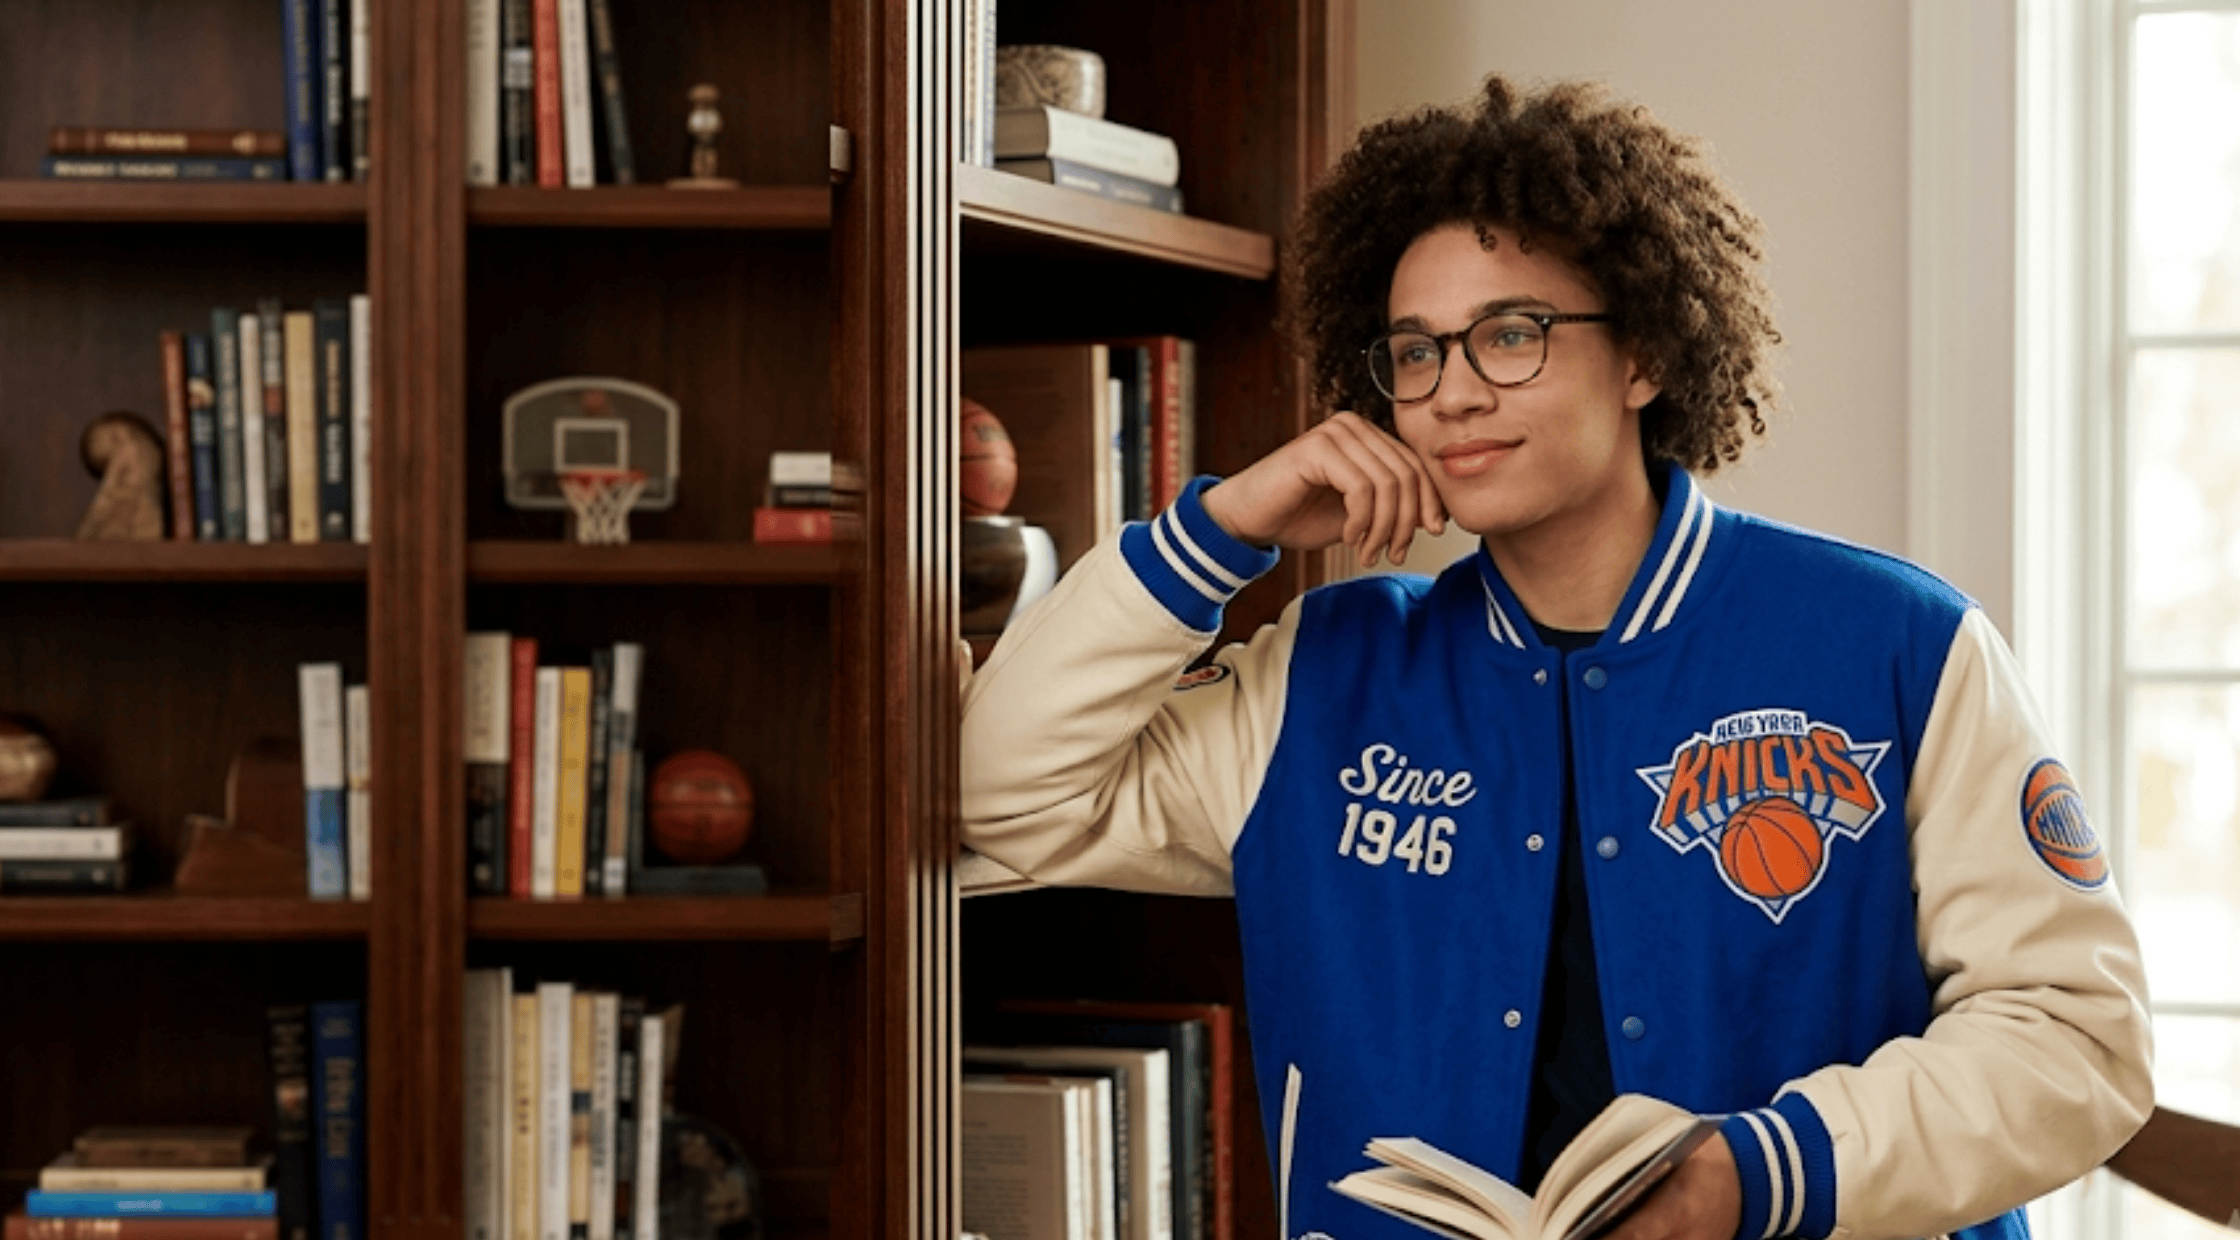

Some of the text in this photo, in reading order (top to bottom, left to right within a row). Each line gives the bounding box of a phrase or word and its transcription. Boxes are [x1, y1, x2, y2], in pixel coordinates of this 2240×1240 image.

[1339, 743, 1478, 806] Since
[1660, 728, 1876, 828] KNICKS
[1338, 803, 1457, 876] 1946
